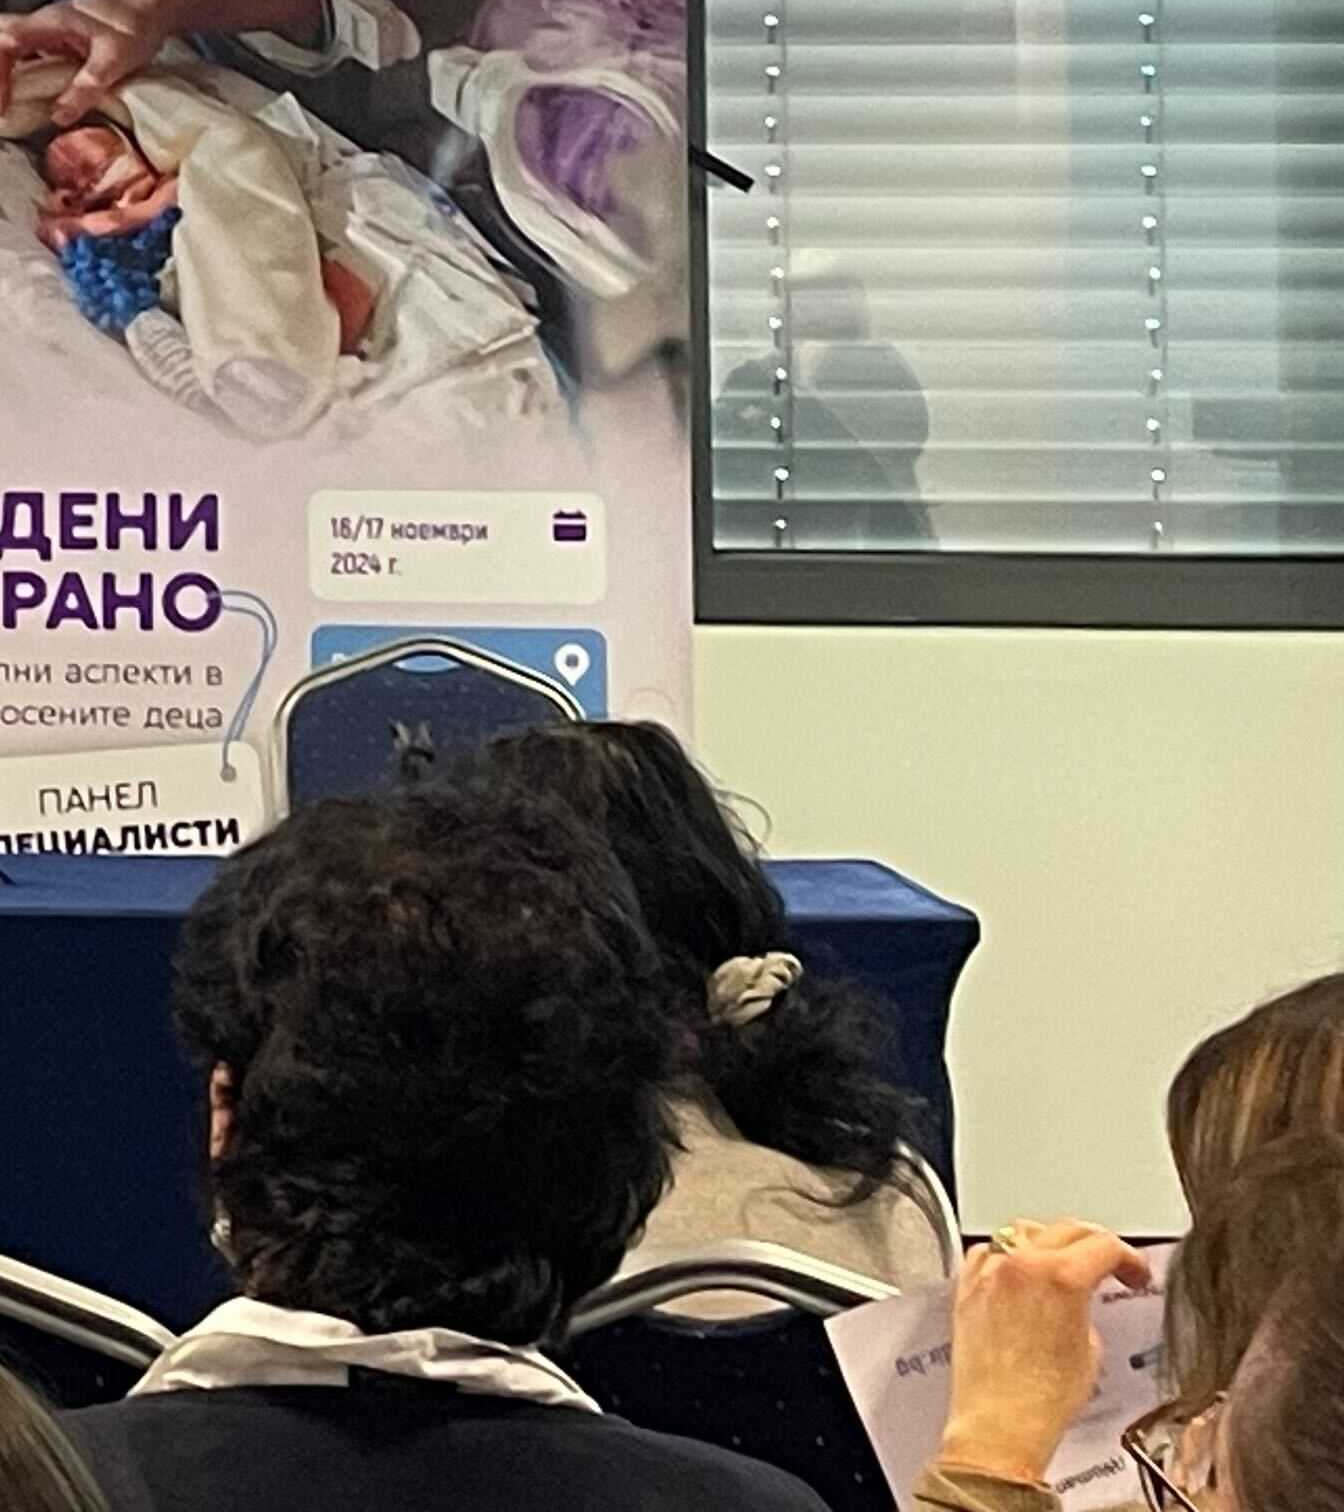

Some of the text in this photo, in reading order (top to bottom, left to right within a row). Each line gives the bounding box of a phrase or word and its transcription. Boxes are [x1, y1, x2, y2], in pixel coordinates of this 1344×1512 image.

[391, 522, 488, 544] ноември
[330, 552, 381, 575] 2024
[2, 572, 222, 632] РАНО
[65, 662, 192, 685] аспекти
[205, 665, 224, 686] в
[143, 707, 223, 729] деца
[39, 781, 158, 815] ПАНЕЛ
